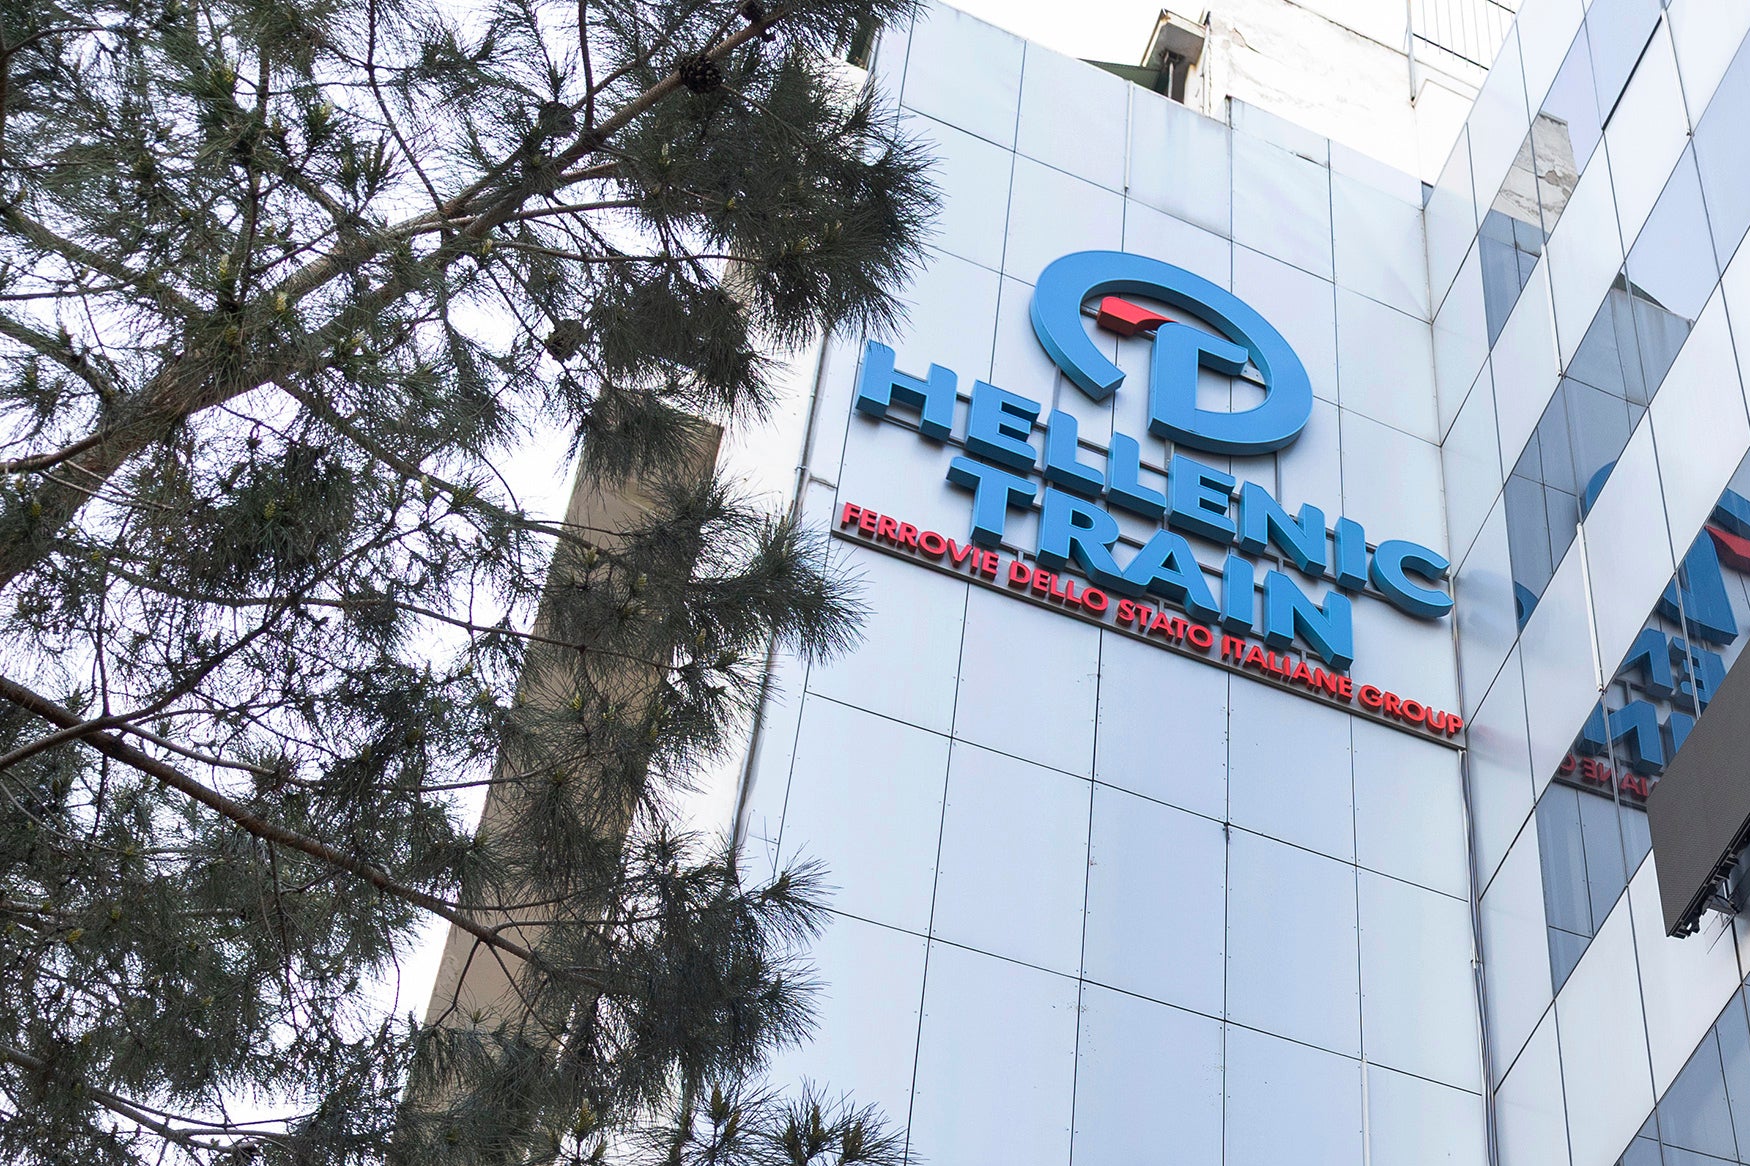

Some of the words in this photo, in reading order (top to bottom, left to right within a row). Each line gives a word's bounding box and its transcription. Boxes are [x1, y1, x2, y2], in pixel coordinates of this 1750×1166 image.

[856, 340, 1454, 619] HELLENIC
[946, 455, 1354, 671] TRAIN
[840, 502, 999, 581] FERROVIE
[1007, 560, 1109, 617] DELLO
[1116, 599, 1214, 650] STATO
[1221, 635, 1354, 703] ITALIANE
[1358, 684, 1463, 739] GROUP
